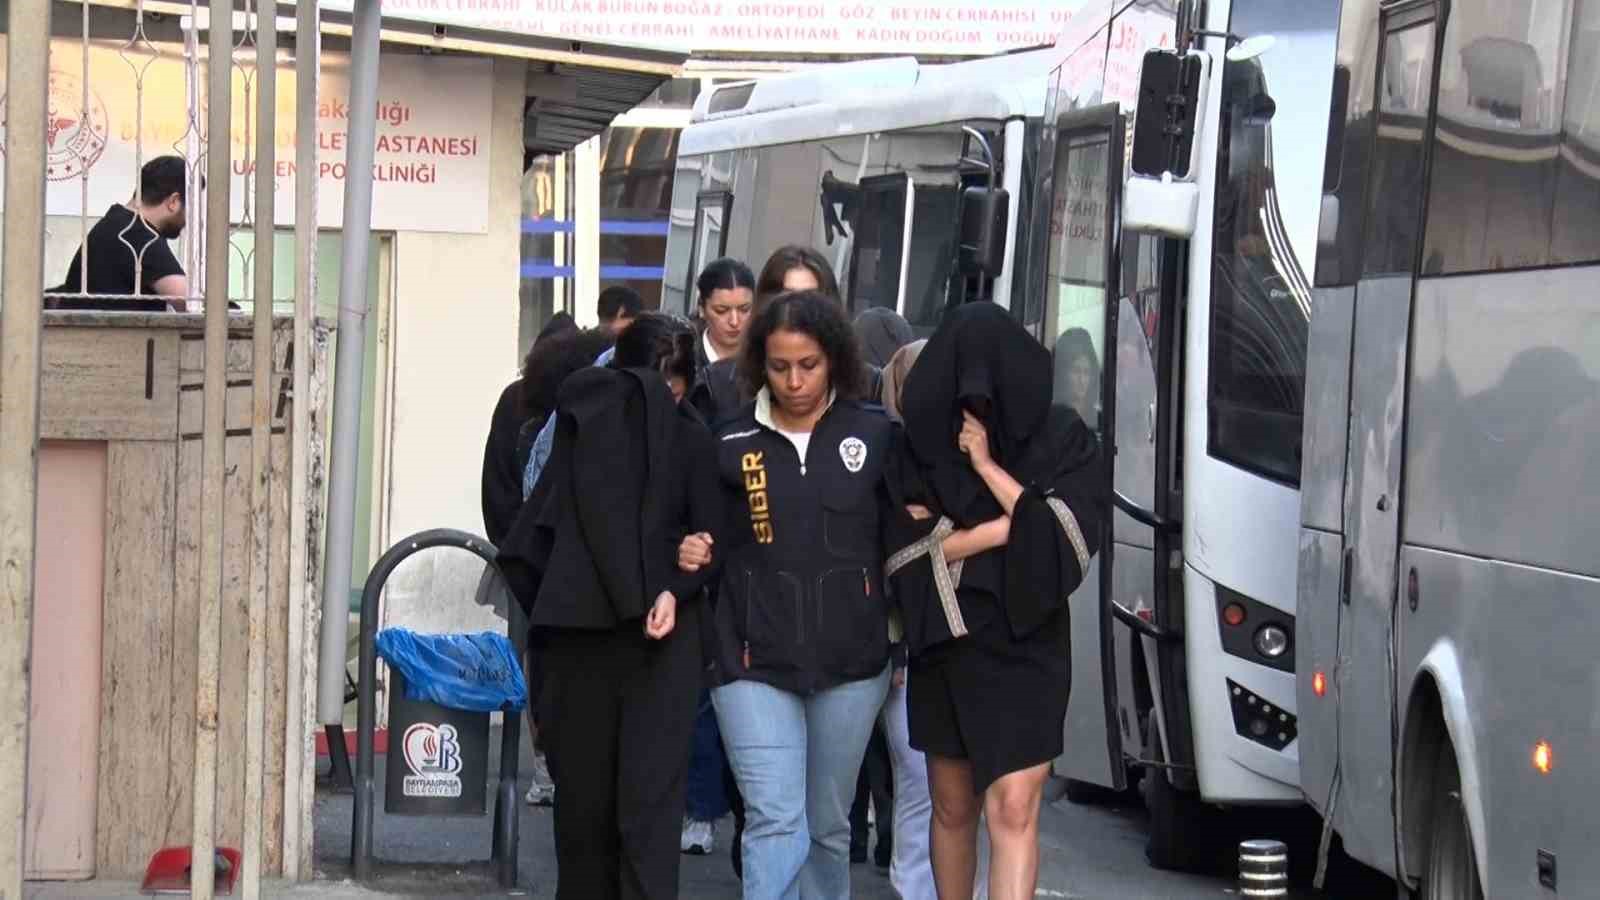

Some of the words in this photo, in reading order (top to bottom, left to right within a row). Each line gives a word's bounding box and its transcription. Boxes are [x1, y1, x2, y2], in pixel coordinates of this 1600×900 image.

[597, 0, 658, 14] BURUN
[663, 1, 722, 16] BOĞAZ
[738, 4, 825, 19] ORTOPEDİ
[840, 4, 875, 19] GÖZ
[945, 7, 1036, 23] CERRAHİSİ
[560, 22, 614, 34] GENEL
[709, 24, 840, 41] AMELİYATHANE
[856, 27, 911, 42] KADIN
[915, 29, 983, 44] DOĞUM
[375, 133, 478, 156] ASTANESİ
